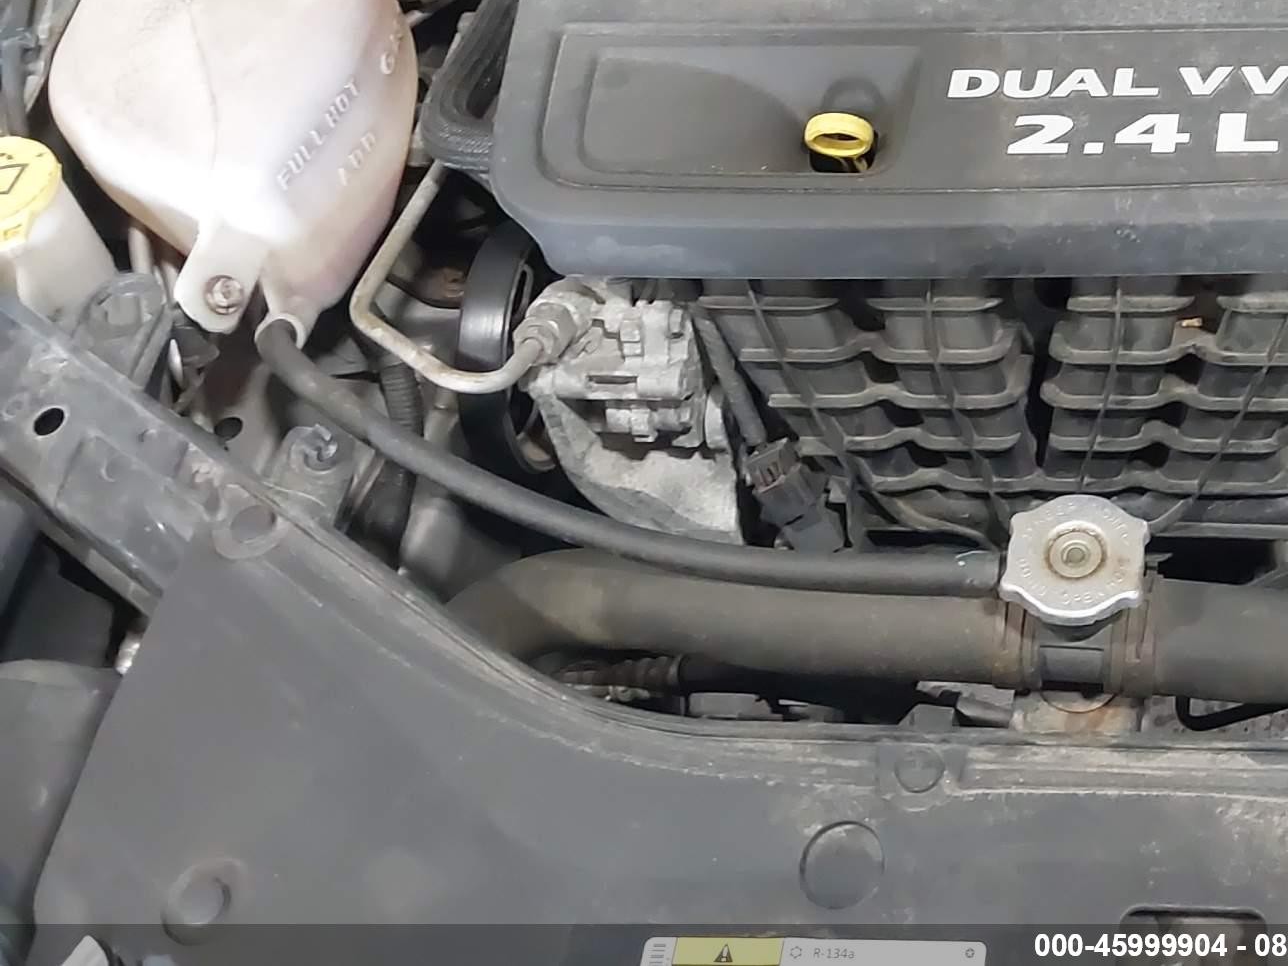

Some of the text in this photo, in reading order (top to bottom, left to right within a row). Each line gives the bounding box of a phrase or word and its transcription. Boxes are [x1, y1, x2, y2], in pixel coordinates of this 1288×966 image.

[947, 67, 1160, 99] DUAL
[276, 75, 360, 191] FULL HOT
[1006, 112, 1280, 155] 2.4 L
[813, 947, 856, 960] R-134a
